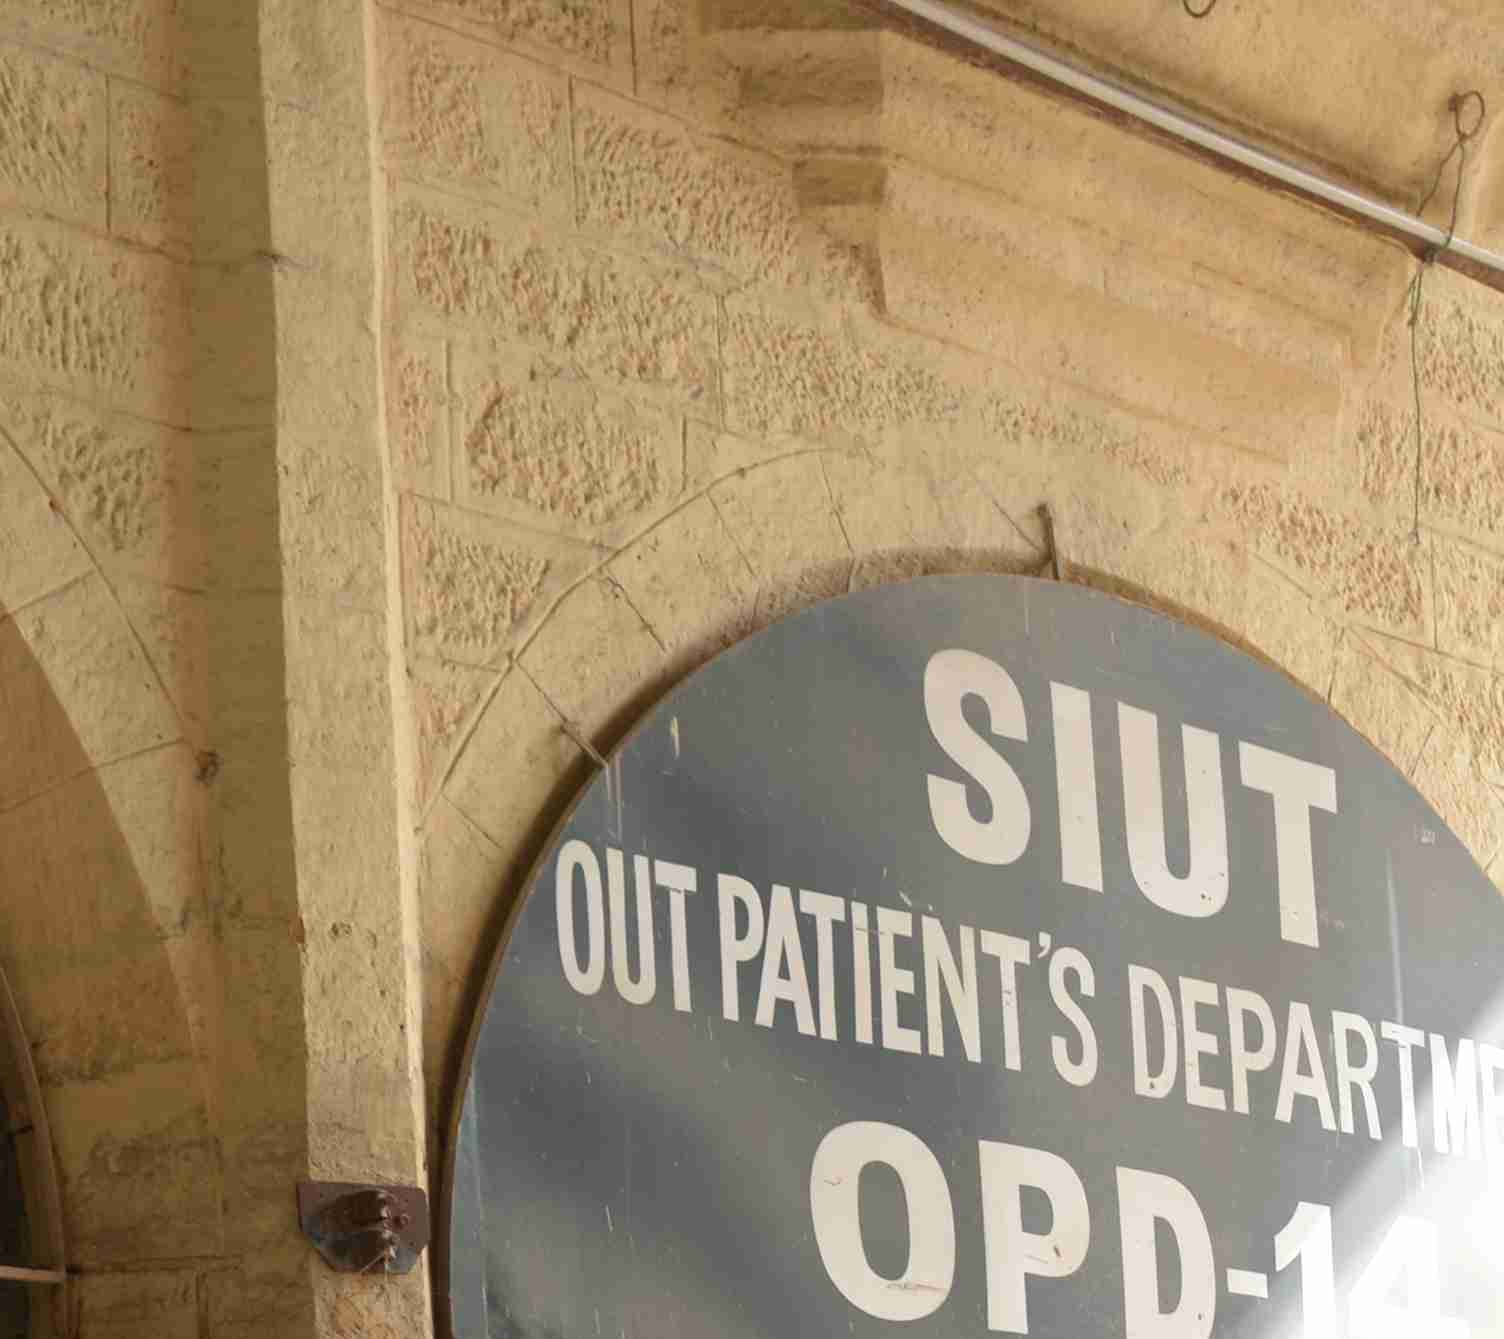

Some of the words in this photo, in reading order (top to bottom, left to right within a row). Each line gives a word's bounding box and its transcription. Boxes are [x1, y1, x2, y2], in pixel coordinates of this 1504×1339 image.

[923, 648, 1338, 949] SIUT
[554, 836, 697, 1013] OUT
[718, 873, 1098, 1088] PATIENT'S
